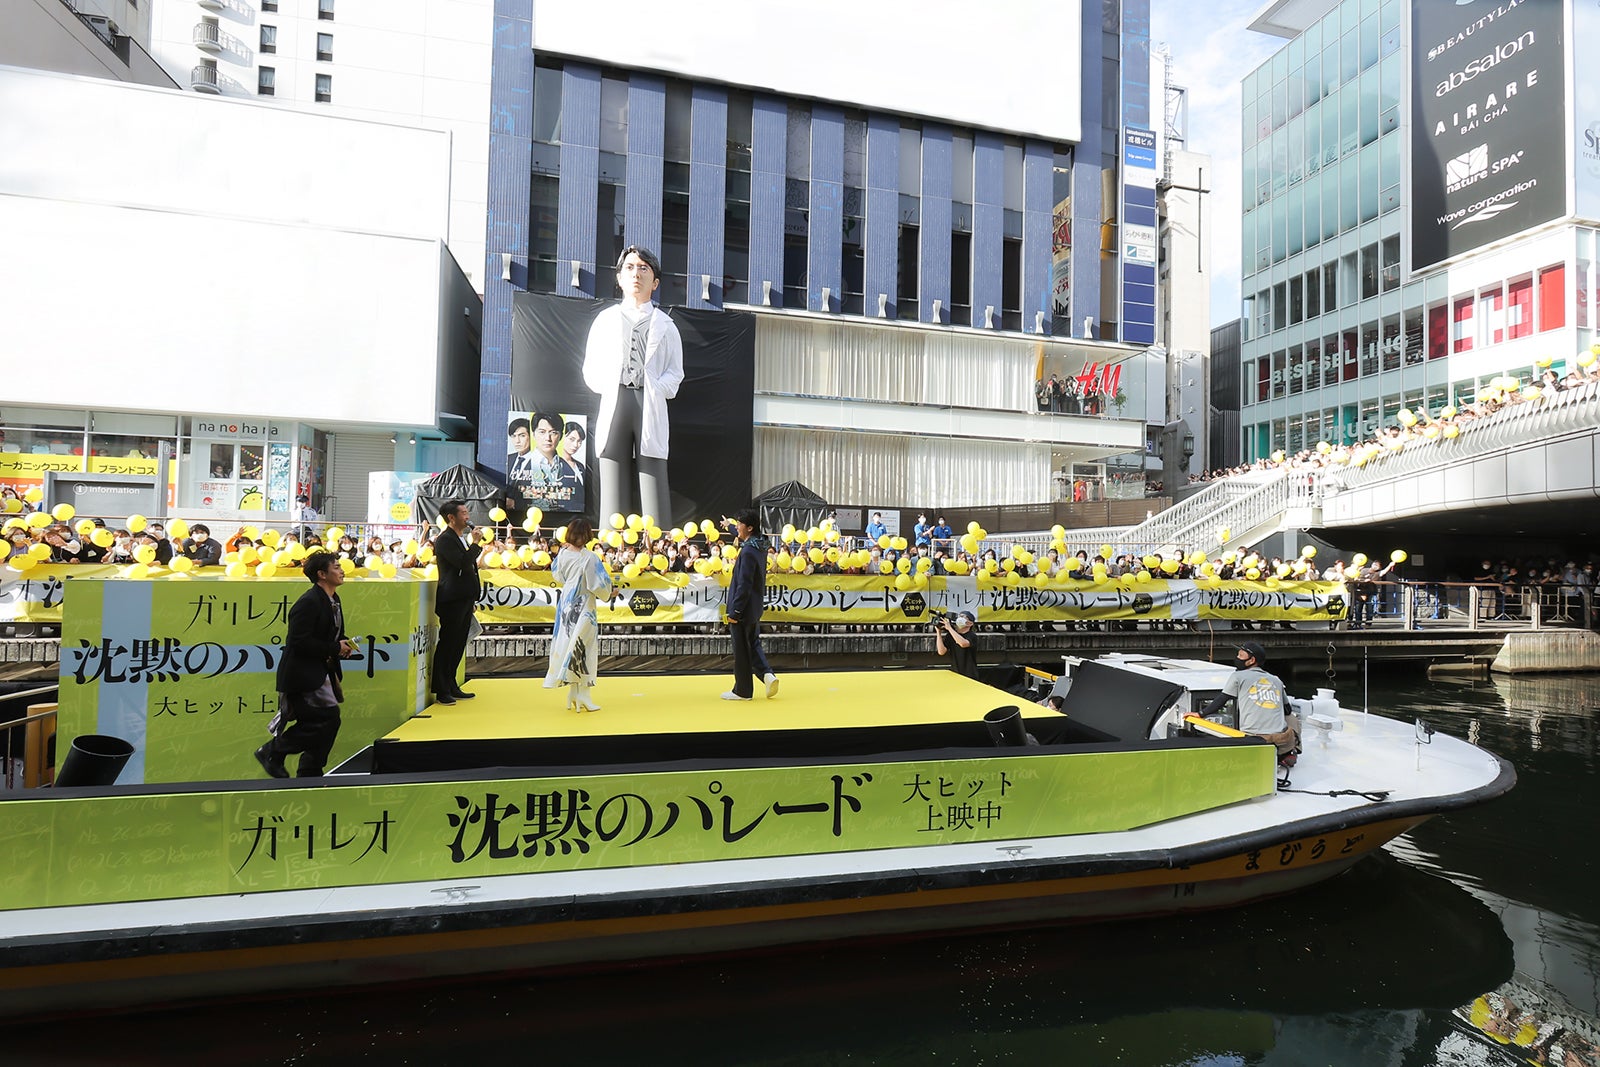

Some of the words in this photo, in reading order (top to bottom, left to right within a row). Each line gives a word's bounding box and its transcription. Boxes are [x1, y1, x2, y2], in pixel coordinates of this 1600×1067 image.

[1436, 30, 1535, 97] abSalon
[1446, 169, 1489, 194] nature
[1491, 154, 1519, 174] SPA
[1437, 209, 1466, 225] Wave
[1468, 178, 1537, 213] corporation
[1074, 361, 1122, 399] H&M
[991, 585, 1131, 612] 沈黙のパレード
[902, 771, 1012, 803] 大ヒット
[446, 772, 873, 864] 沈黙のパレード
[917, 801, 1002, 832] 上映中
[232, 810, 396, 877] ガリレオ
